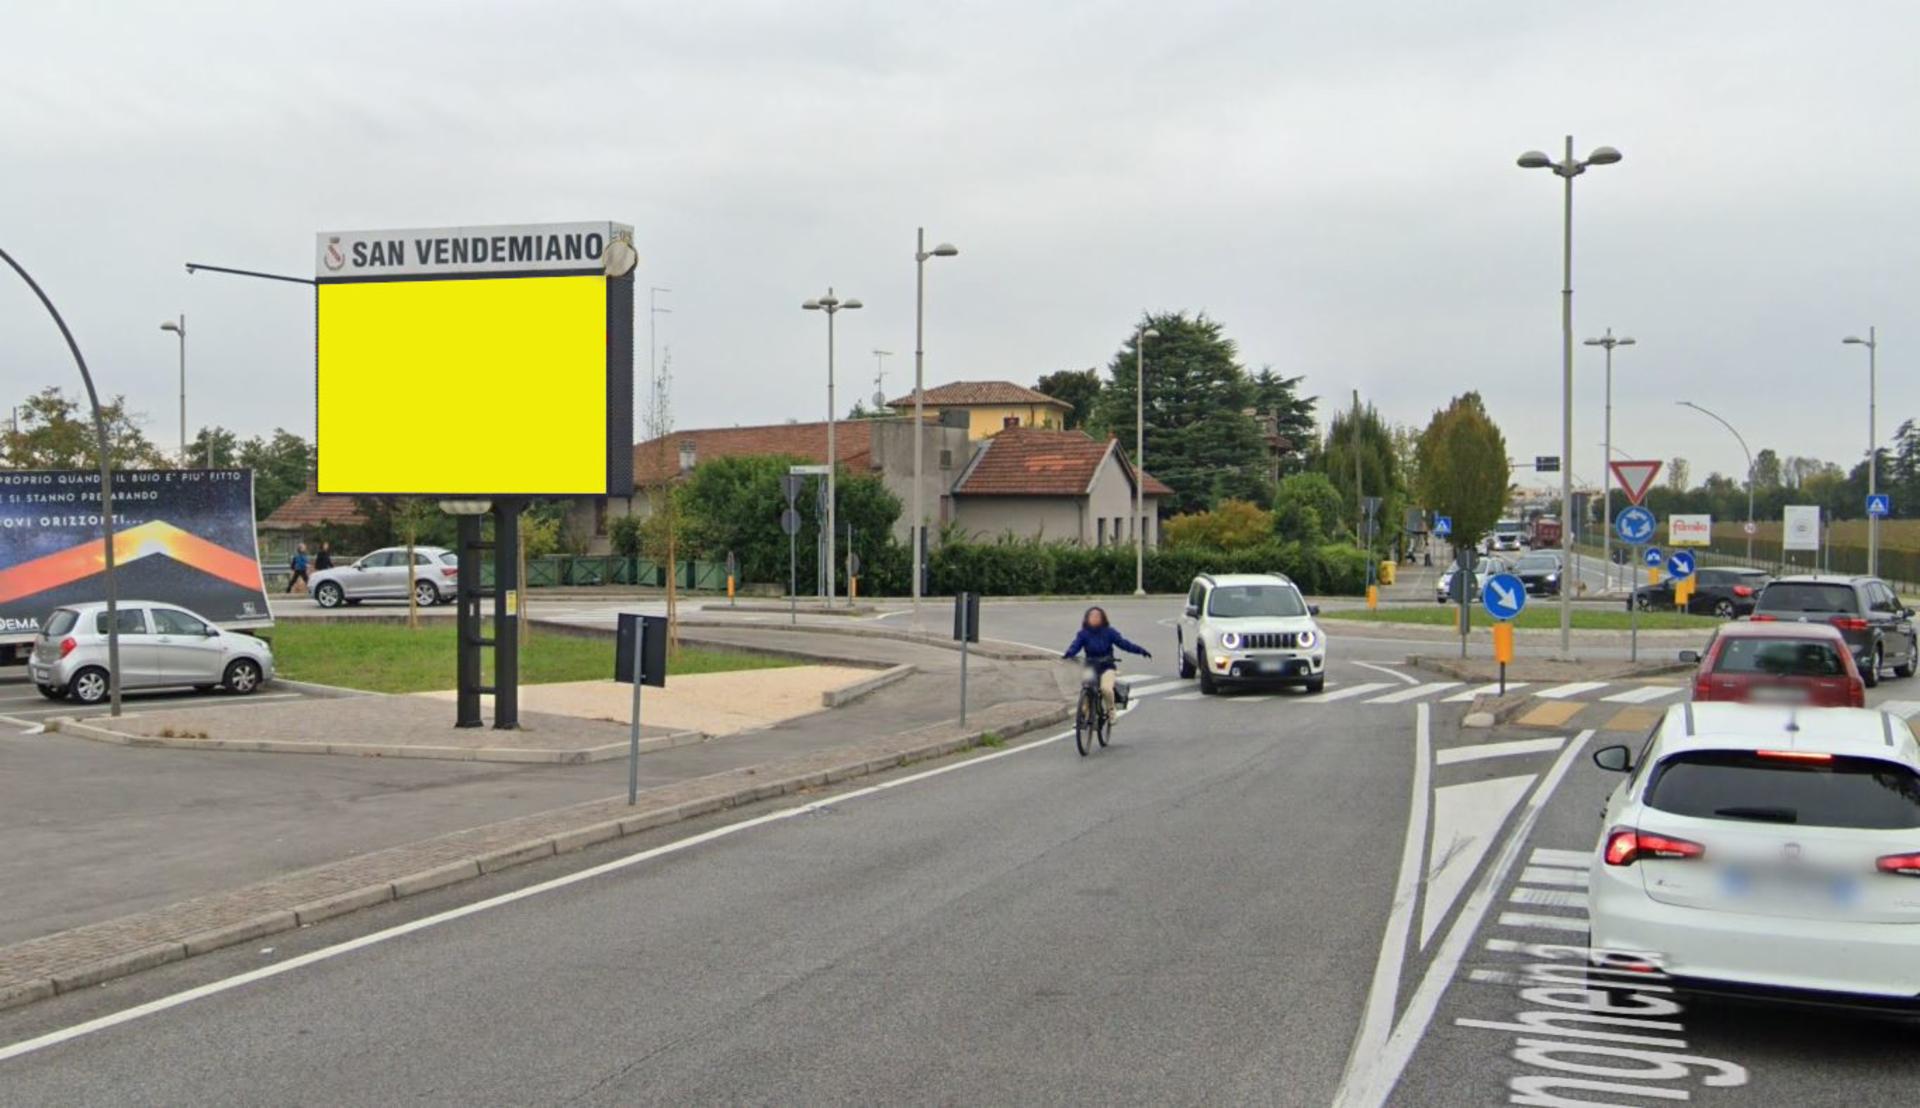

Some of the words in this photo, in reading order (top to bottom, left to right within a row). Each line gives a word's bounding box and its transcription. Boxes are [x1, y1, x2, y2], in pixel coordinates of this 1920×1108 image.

[352, 240, 405, 268] SAN
[414, 232, 603, 266] VENDEMIANO
[57, 474, 102, 484] QUAND
[132, 473, 160, 483] BUIO
[209, 471, 241, 482] FITTO
[26, 493, 75, 503] STANNO
[81, 490, 158, 502] PREARANDO
